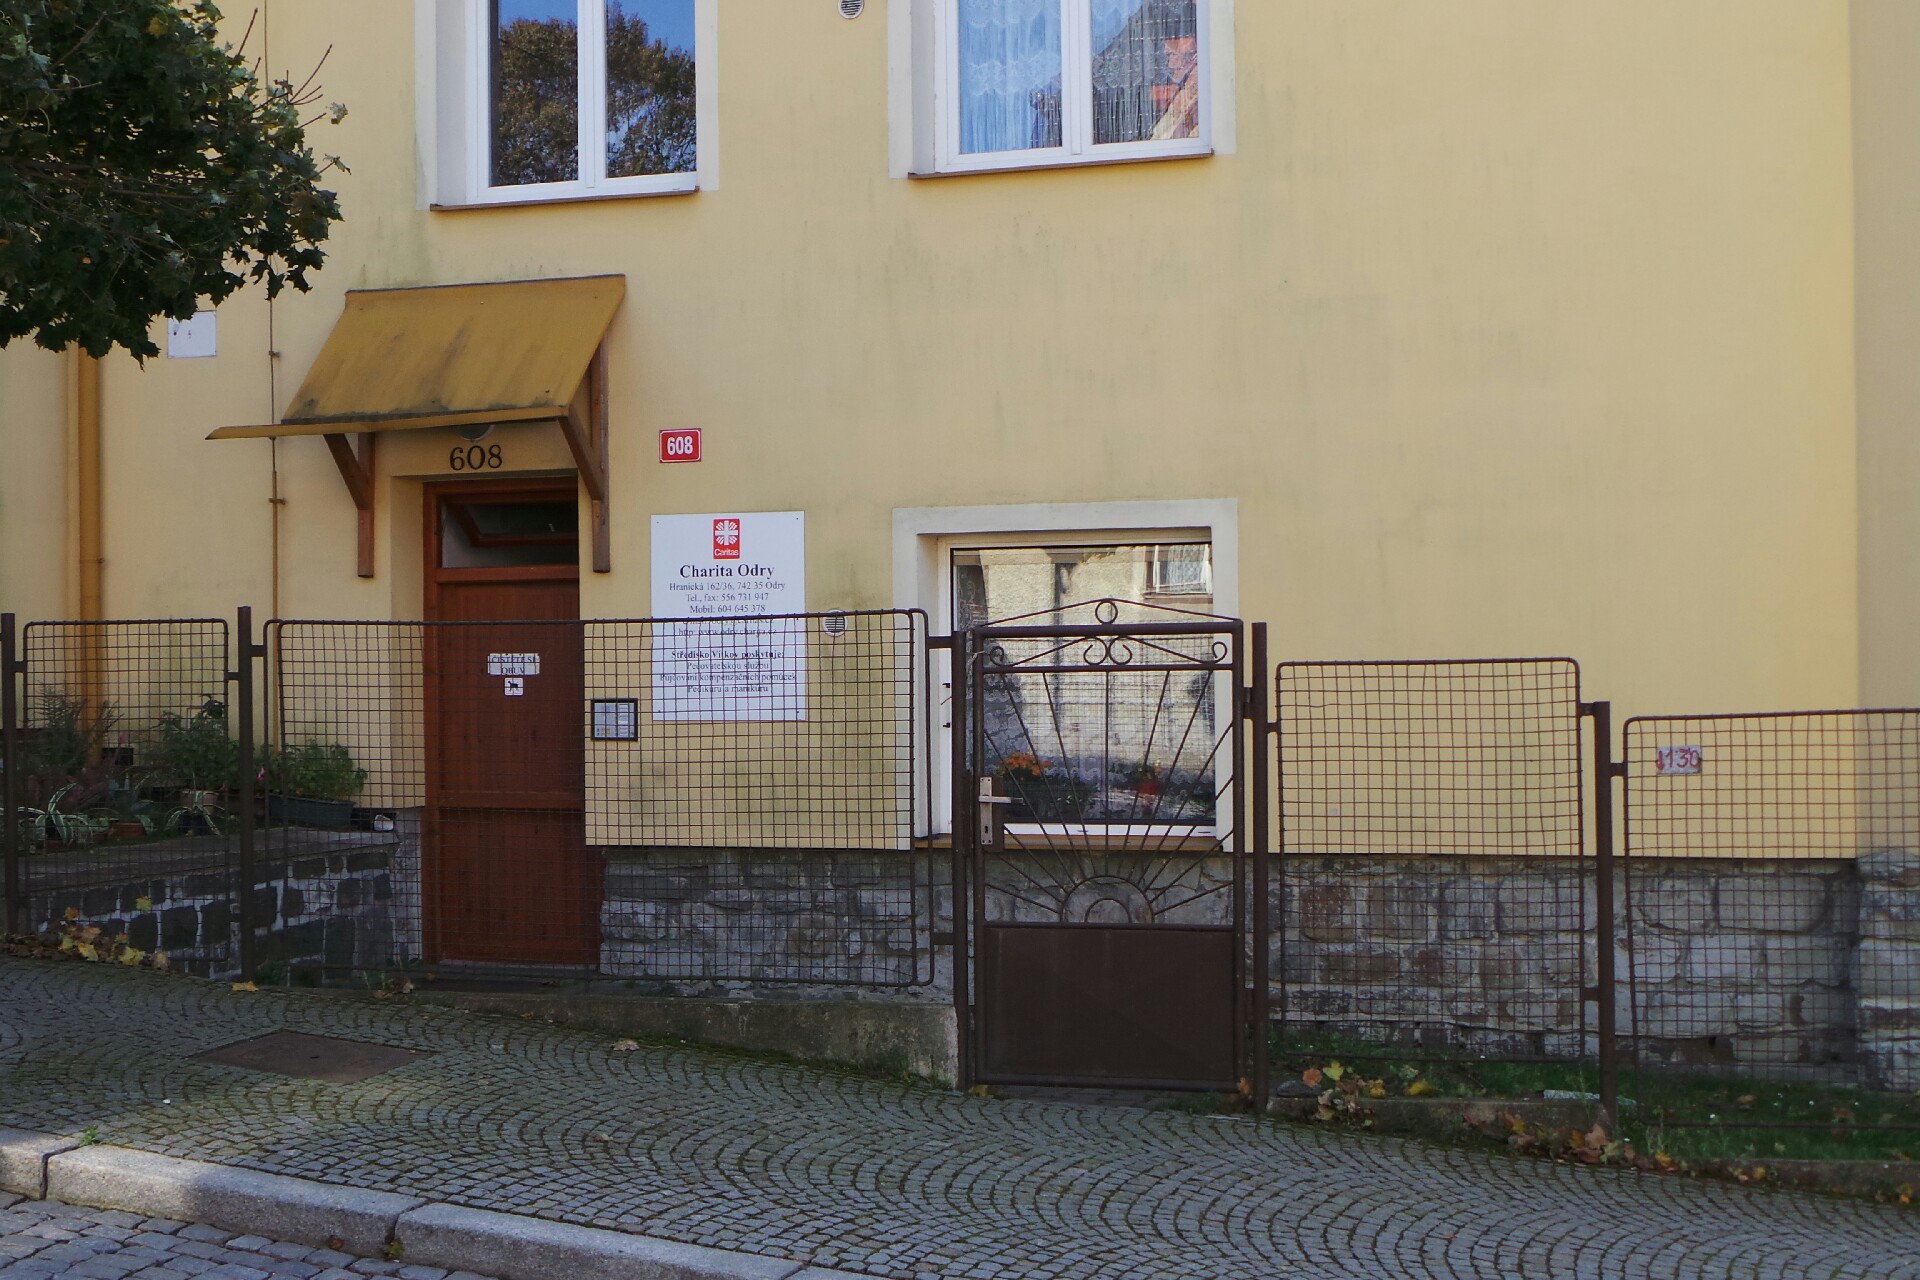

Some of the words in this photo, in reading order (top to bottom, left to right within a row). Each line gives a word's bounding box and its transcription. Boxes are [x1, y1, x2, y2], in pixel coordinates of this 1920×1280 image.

[667, 436, 693, 456] 608
[450, 444, 504, 471] 608
[714, 548, 739, 556] Caritas
[680, 564, 733, 579] Charita
[738, 563, 775, 580] Odry
[669, 582, 704, 591] Hranická
[707, 582, 735, 591] 162/36,
[737, 581, 751, 590] 742
[753, 581, 763, 590] 35
[765, 581, 786, 591] Odry
[704, 593, 719, 602] fax:
[721, 593, 736, 601] 556
[738, 592, 752, 601] 731
[754, 592, 769, 601] 947
[690, 605, 715, 613] Mobil:
[717, 605, 732, 613] 604
[734, 604, 749, 613] 645
[751, 604, 766, 612] 378
[671, 650, 709, 659] Středisko
